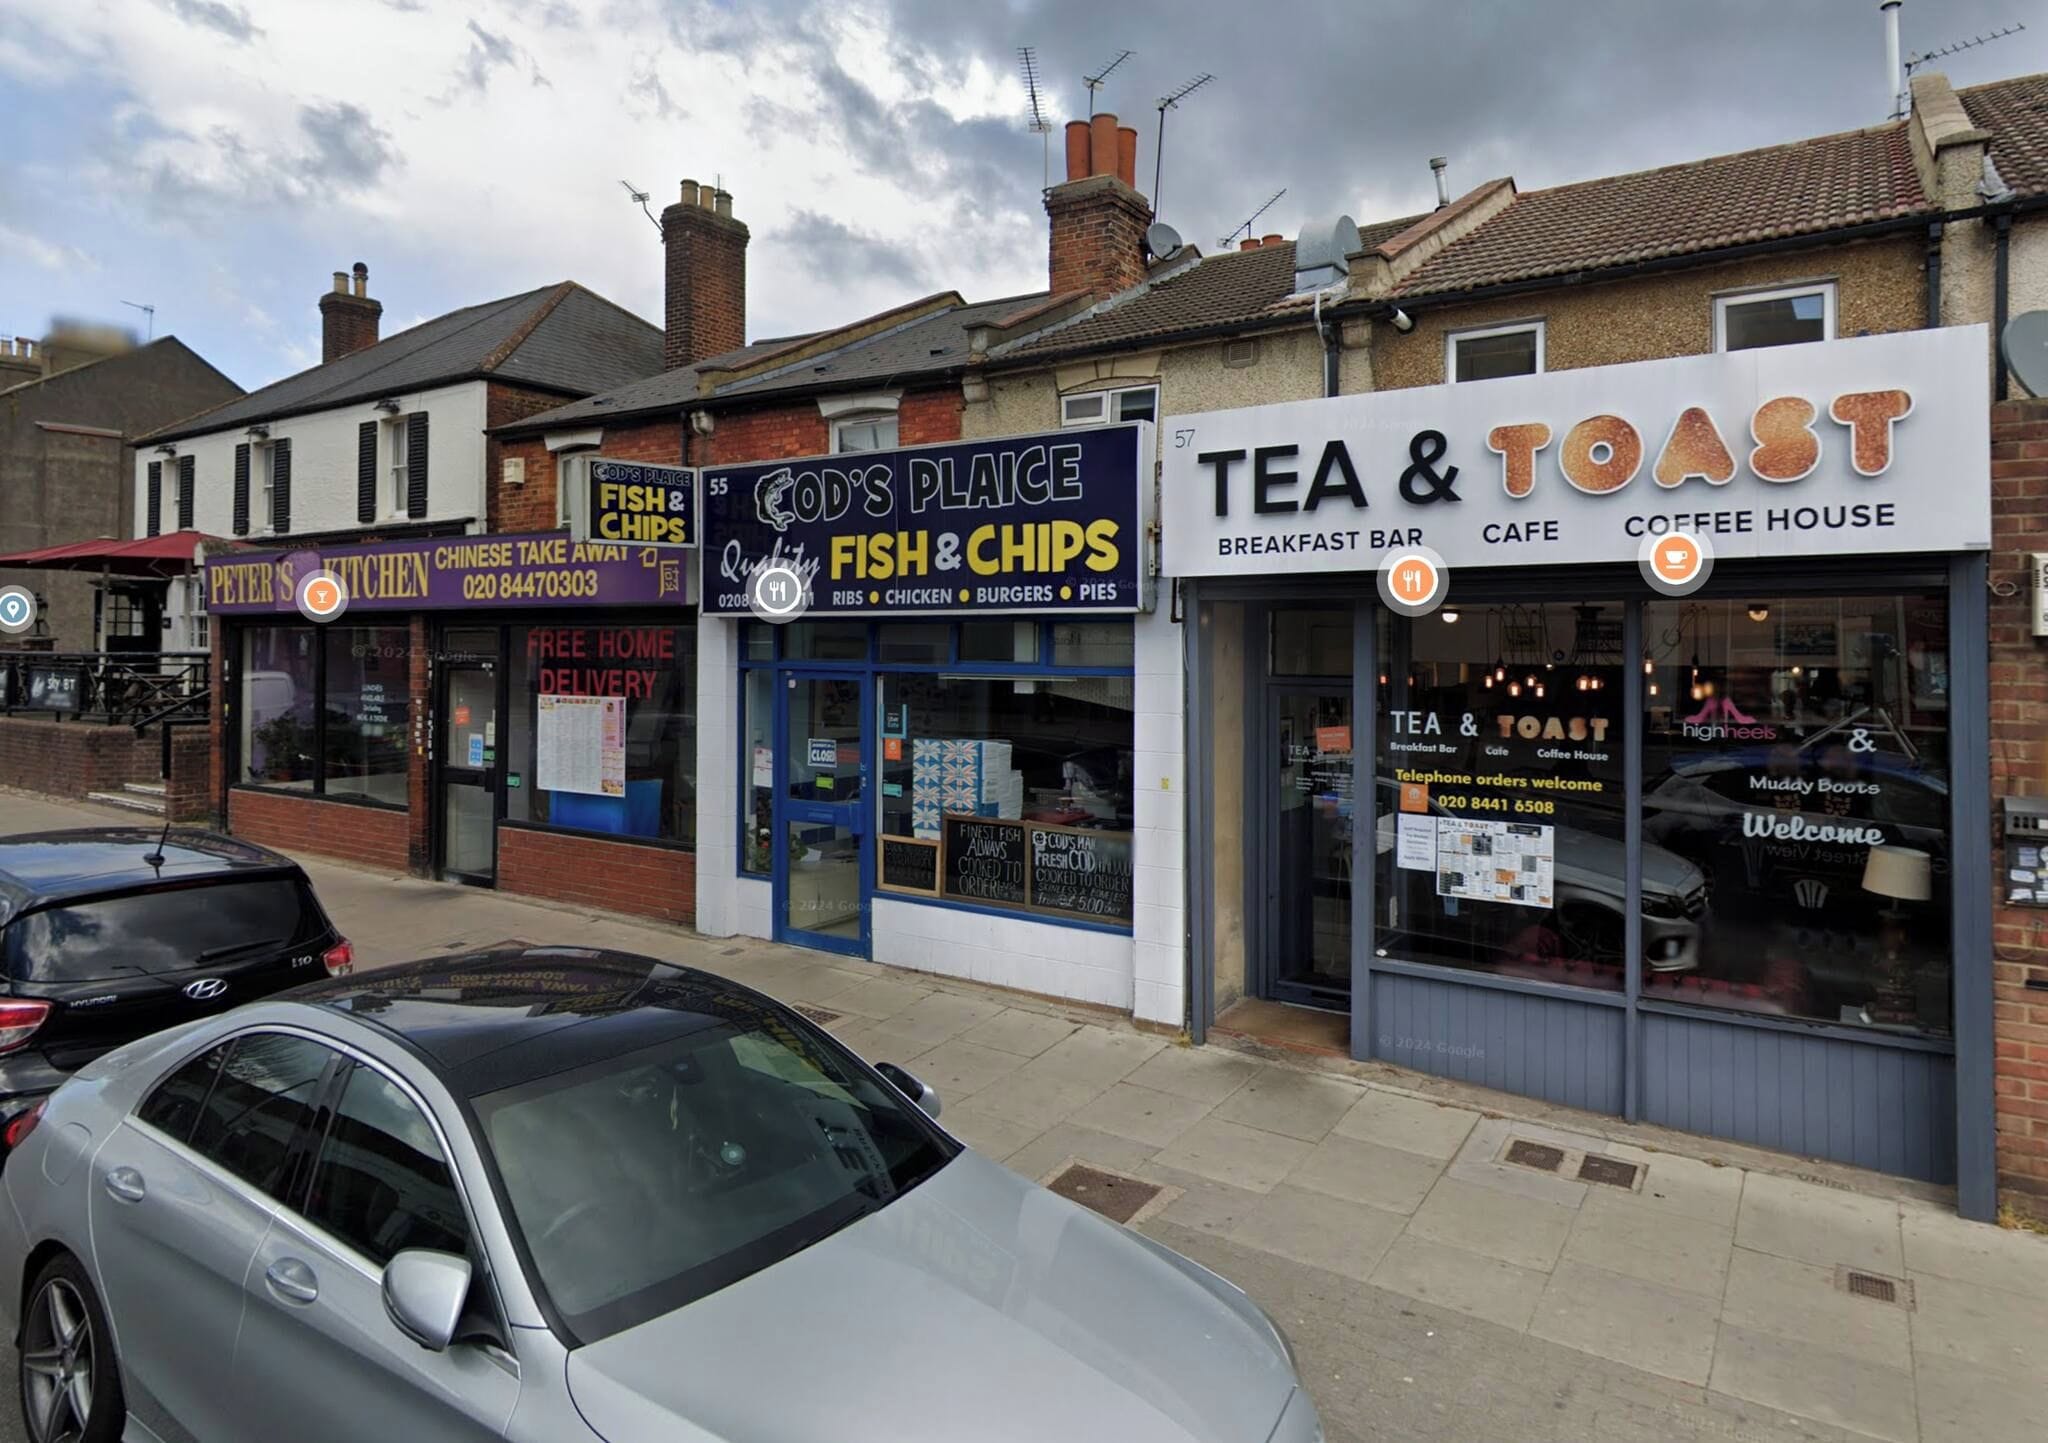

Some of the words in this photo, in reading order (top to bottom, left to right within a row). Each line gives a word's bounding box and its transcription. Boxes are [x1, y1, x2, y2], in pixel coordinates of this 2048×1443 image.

[1175, 429, 1195, 448] 57
[1198, 439, 1368, 516] TEA
[1399, 429, 1461, 504] &
[1486, 388, 1915, 499] TOAST
[644, 468, 691, 487] PLAICE
[710, 478, 728, 495] 55
[910, 443, 1082, 513] PLAICE
[600, 483, 665, 512] FISH
[668, 491, 685, 511] &
[600, 512, 685, 543] CHIPS
[1482, 520, 1559, 544] CAFE
[1624, 510, 1754, 538] COFFEE
[1767, 503, 1896, 530] HOUSE
[434, 543, 512, 570] CHINESE
[517, 539, 567, 565] TAKE
[831, 530, 928, 580] FISH
[935, 532, 962, 571] &
[966, 519, 1119, 576] CHIPS
[1218, 531, 1359, 556] BREAKFAST
[1370, 528, 1423, 549] BAR
[210, 560, 294, 605] PETER'S
[323, 552, 430, 600] KITCHEN
[463, 573, 497, 599] 020
[500, 569, 598, 598] 84470303
[719, 593, 749, 607] 0208
[833, 591, 863, 606] RIBS
[885, 588, 952, 605] CHICKEN
[977, 585, 1053, 604] BURGERS
[1080, 584, 1117, 600] PIES
[527, 629, 586, 659] FREE
[597, 628, 674, 659] HOME
[540, 668, 657, 699] DELIVERY
[1390, 710, 1441, 735] TEA
[1460, 712, 1478, 737] &
[1497, 715, 1609, 741] TOAST
[1390, 742, 1437, 754] Breakfast
[1439, 743, 1458, 754] Bar
[1485, 745, 1509, 757] Cafe
[1537, 748, 1572, 760] Coffee
[1574, 750, 1609, 761] House
[1849, 728, 1877, 752] &
[1395, 768, 1472, 785] Telephone
[1476, 773, 1527, 788] orders
[1531, 776, 1603, 792] welcome
[1750, 775, 1814, 795] Muddy
[1818, 778, 1881, 795] Boots
[1438, 795, 1467, 808] 020
[1471, 797, 1509, 811] 8441
[1514, 800, 1555, 815] 6508
[960, 823, 995, 841] FINEST
[999, 825, 1021, 842] FISH
[1742, 812, 1886, 846] Welcome
[966, 837, 1007, 860] ALWAYS
[1035, 847, 1068, 870] FRESH
[1068, 849, 1096, 873] COD
[958, 855, 1000, 878] COOKED
[1005, 860, 1022, 883] TO
[1035, 868, 1076, 886] COOKED
[1078, 872, 1092, 887] TO
